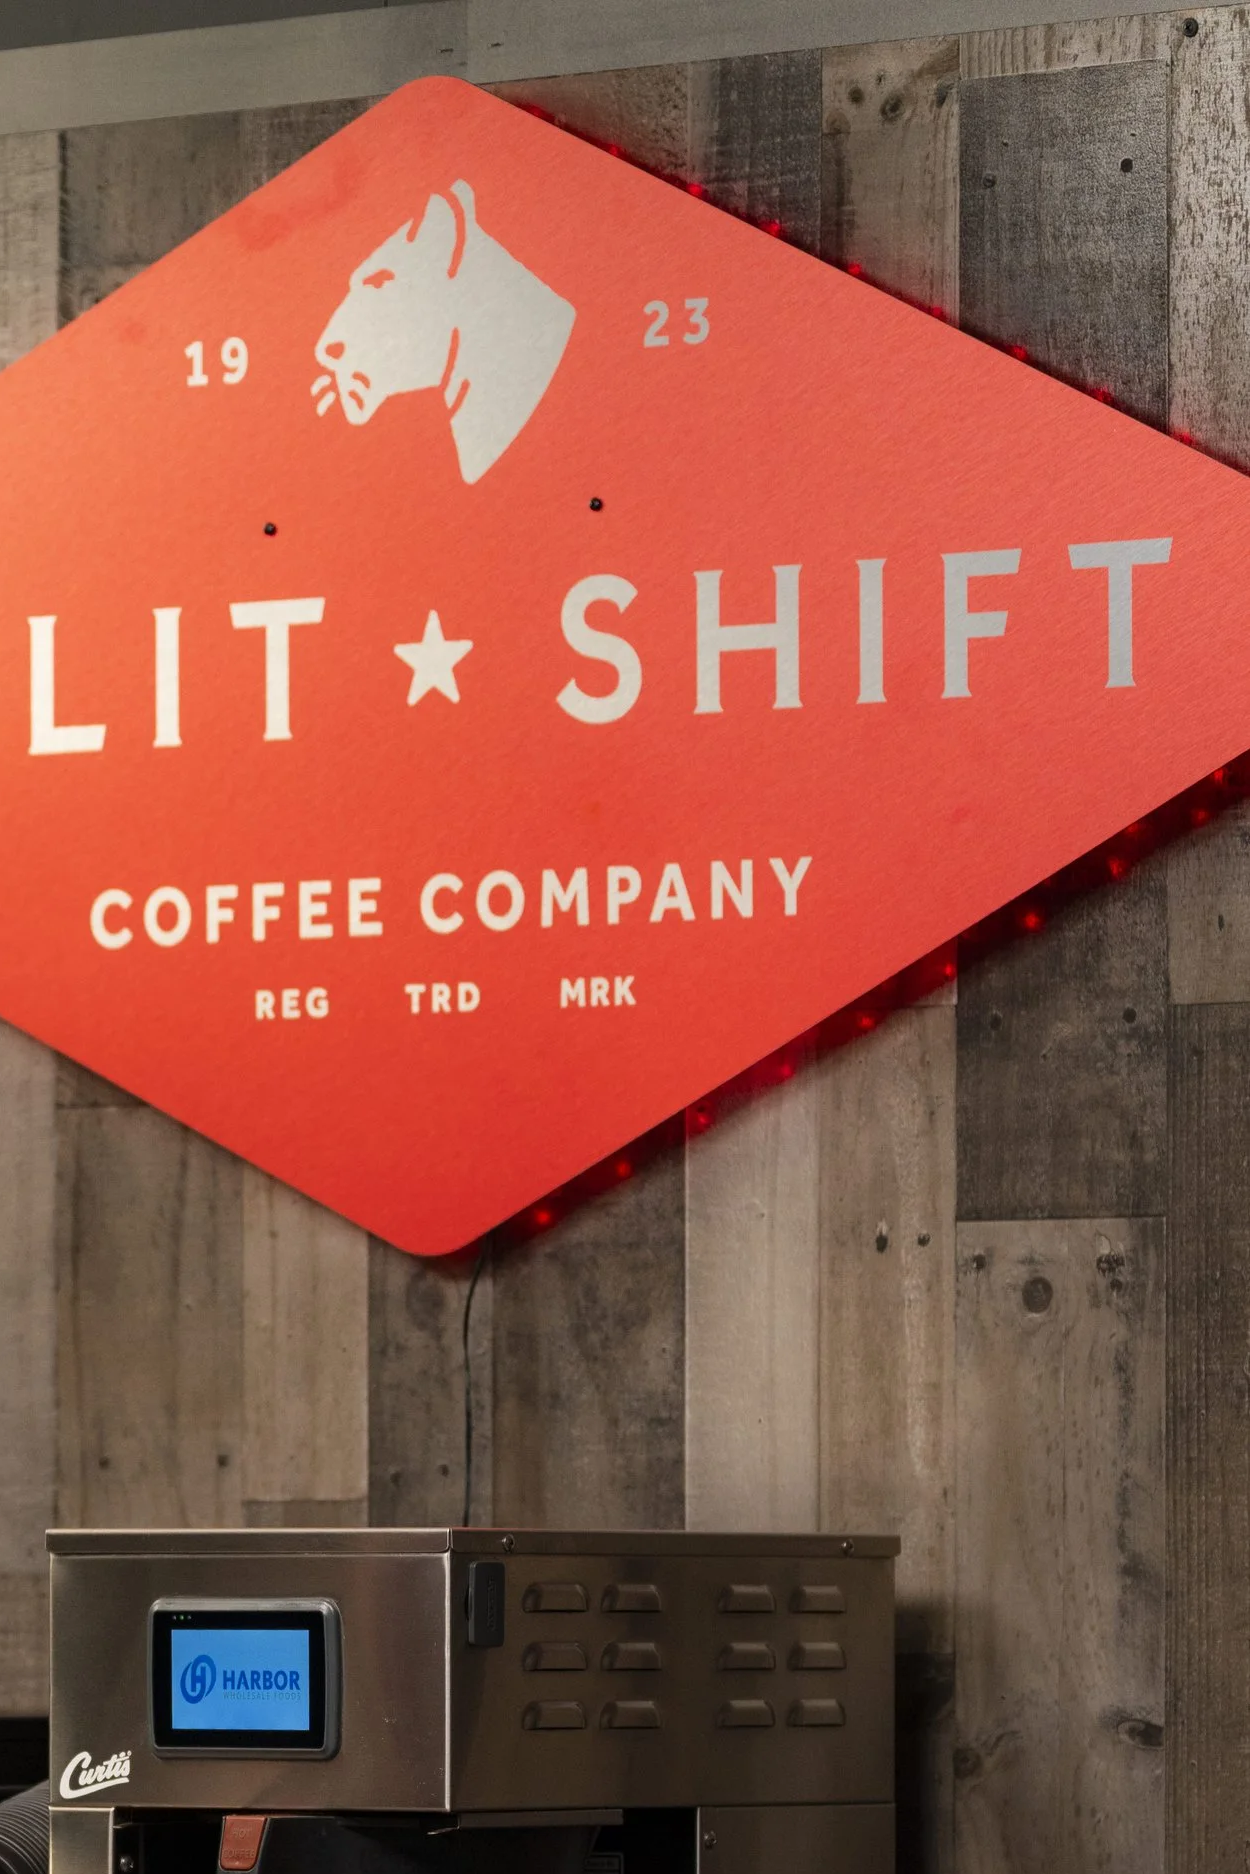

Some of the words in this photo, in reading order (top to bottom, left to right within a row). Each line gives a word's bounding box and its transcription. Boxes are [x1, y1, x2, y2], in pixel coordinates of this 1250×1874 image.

[643, 297, 710, 348] 23
[184, 336, 248, 387] 19
[555, 536, 1174, 725] SHIFT
[89, 877, 384, 950] COFFEE
[419, 855, 813, 935] COMPANY
[255, 986, 330, 1021] REG
[404, 982, 481, 1014] TRD
[559, 975, 637, 1008] MRK
[222, 1669, 301, 1691] HARBOR
[223, 1691, 272, 1700] WHOLESALE
[59, 1750, 132, 1799] Curtis
